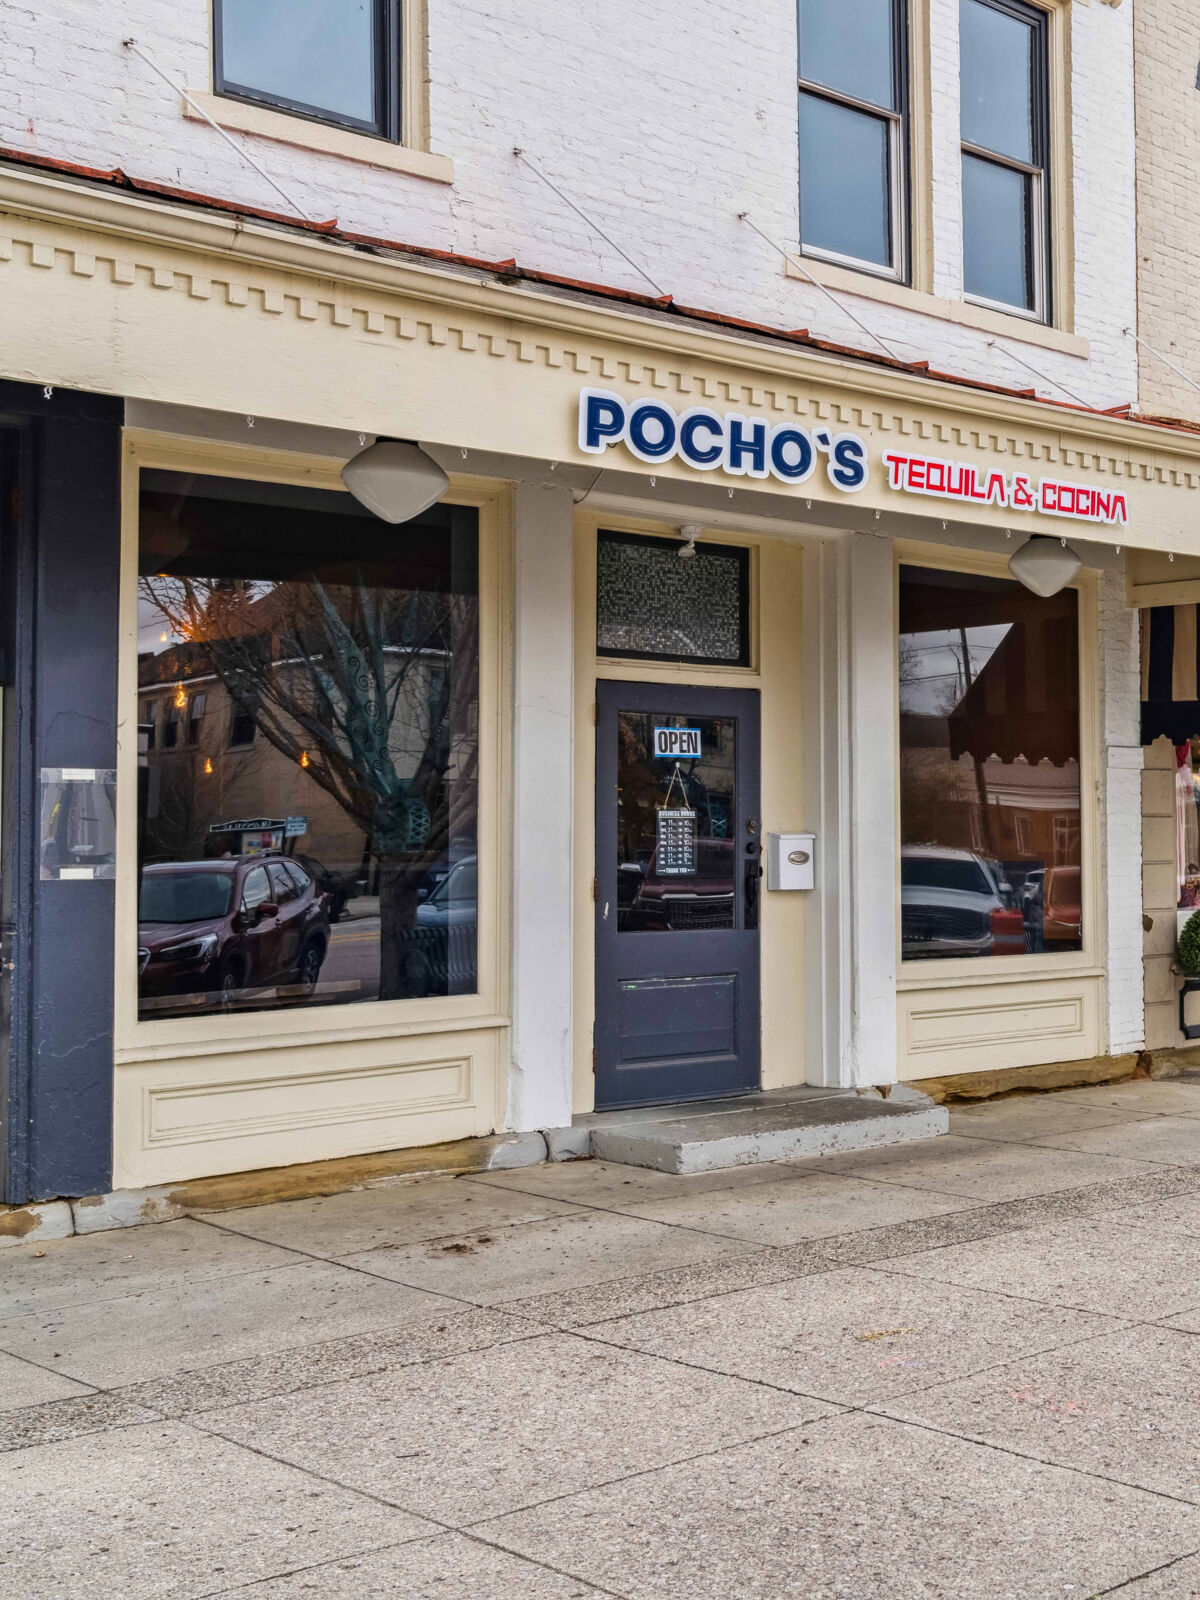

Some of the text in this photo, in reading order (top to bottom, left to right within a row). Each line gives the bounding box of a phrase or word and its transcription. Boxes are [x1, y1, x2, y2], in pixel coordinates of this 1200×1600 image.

[586, 395, 864, 487] POCHO'S
[886, 454, 1128, 522] TEQUILA & COCINA
[658, 730, 698, 754] OPEN
